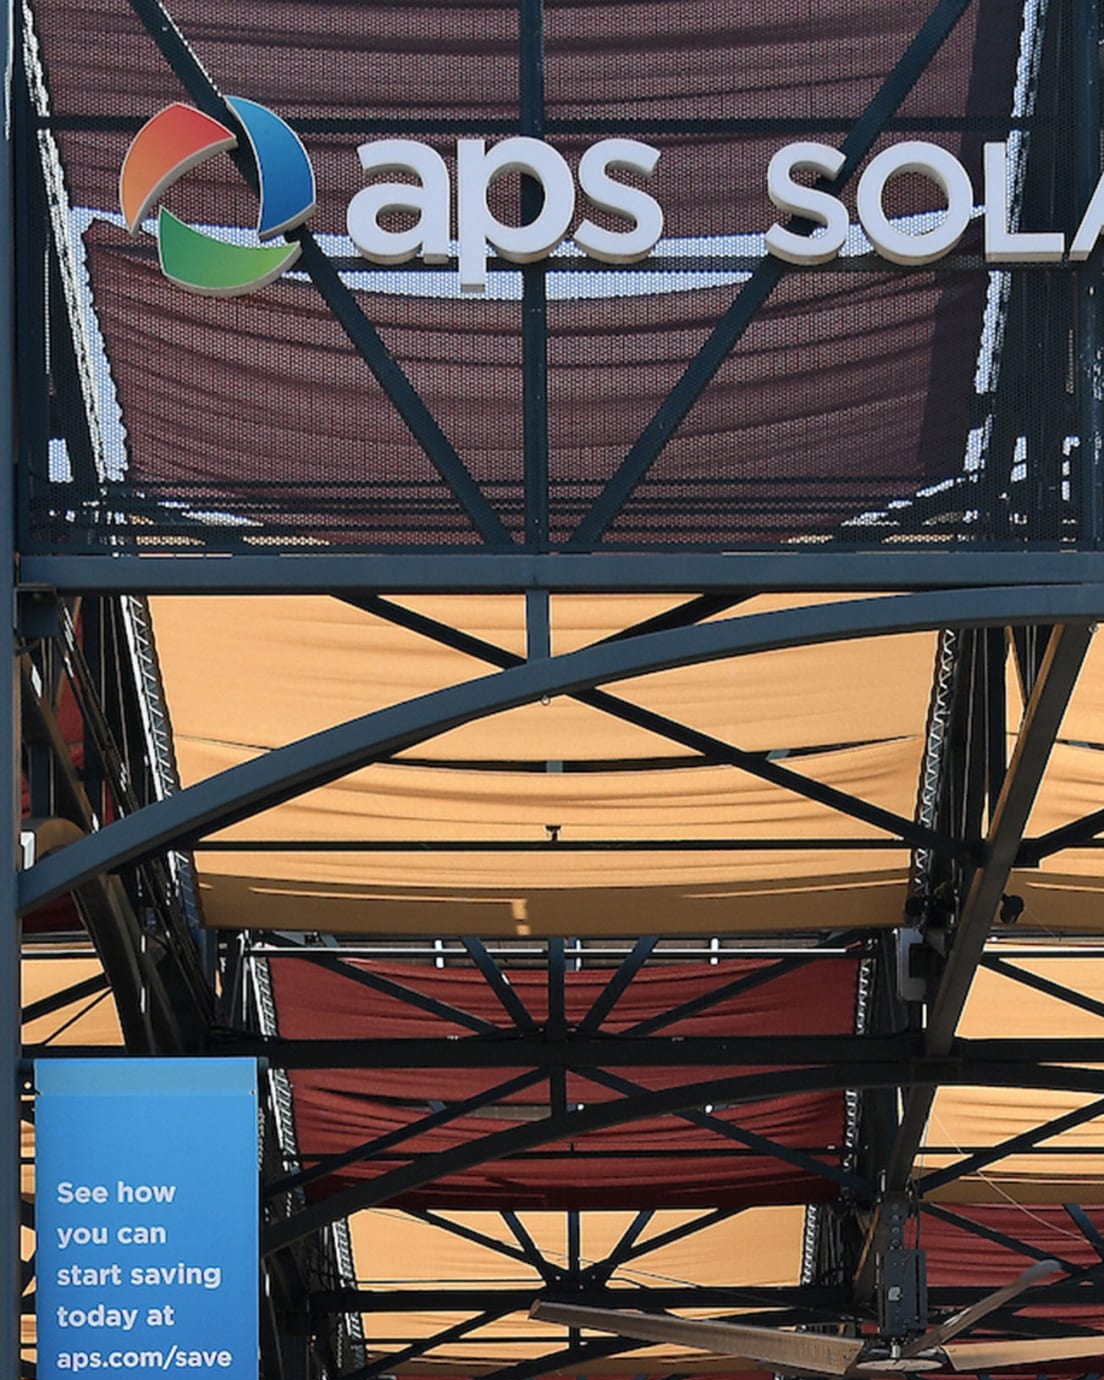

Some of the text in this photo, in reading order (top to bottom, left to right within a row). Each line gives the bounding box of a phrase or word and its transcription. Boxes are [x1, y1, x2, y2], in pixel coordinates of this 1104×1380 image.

[347, 136, 665, 292] aps
[57, 1180, 176, 1204] See how
[57, 1226, 167, 1249] you can
[57, 1263, 222, 1289] start saving
[57, 1304, 175, 1330] today at
[57, 1344, 233, 1372] aps.com/save
